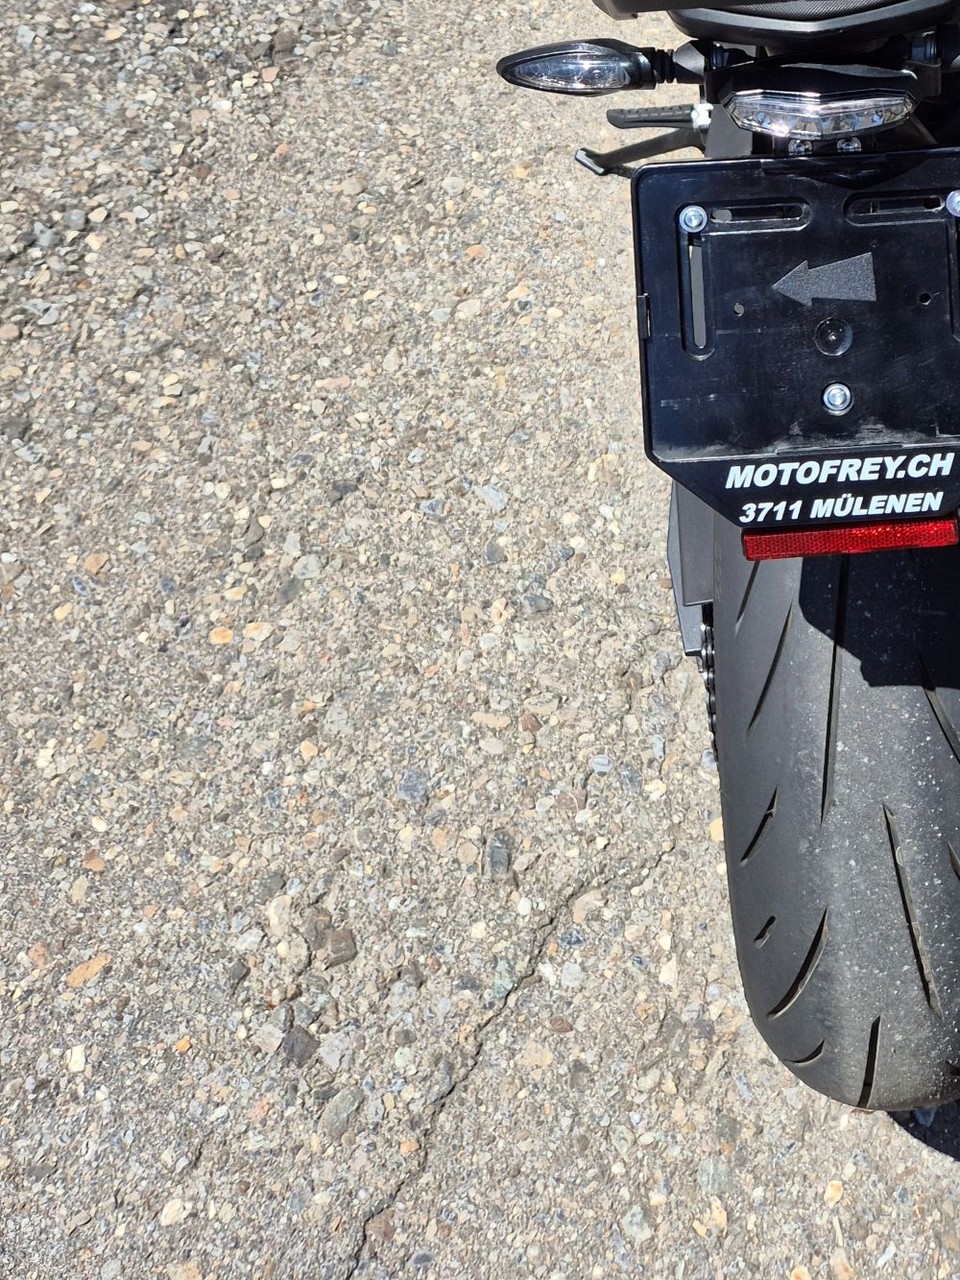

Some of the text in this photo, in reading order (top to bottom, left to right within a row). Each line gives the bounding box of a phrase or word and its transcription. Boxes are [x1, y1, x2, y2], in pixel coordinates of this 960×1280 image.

[726, 453, 955, 488] MOTOFREY.CH
[739, 492, 943, 523] 3711 MÜLENEN
